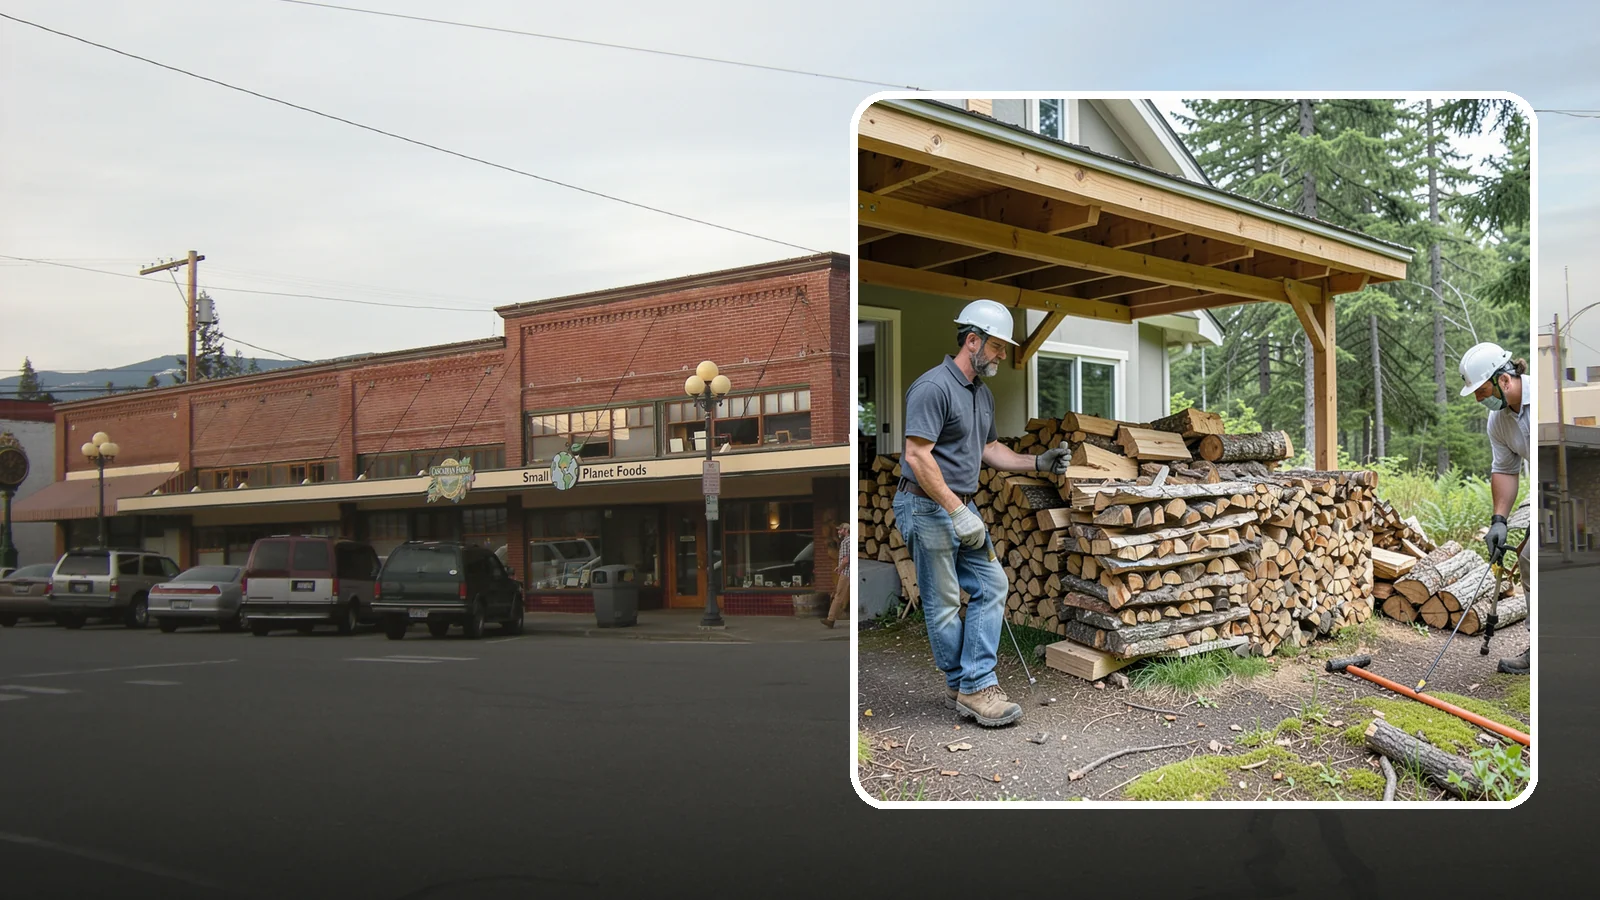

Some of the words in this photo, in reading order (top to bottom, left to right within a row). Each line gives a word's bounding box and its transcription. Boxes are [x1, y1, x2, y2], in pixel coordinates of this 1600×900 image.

[523, 471, 549, 483] Small
[583, 467, 614, 479] Planet
[617, 464, 647, 477] Foods
